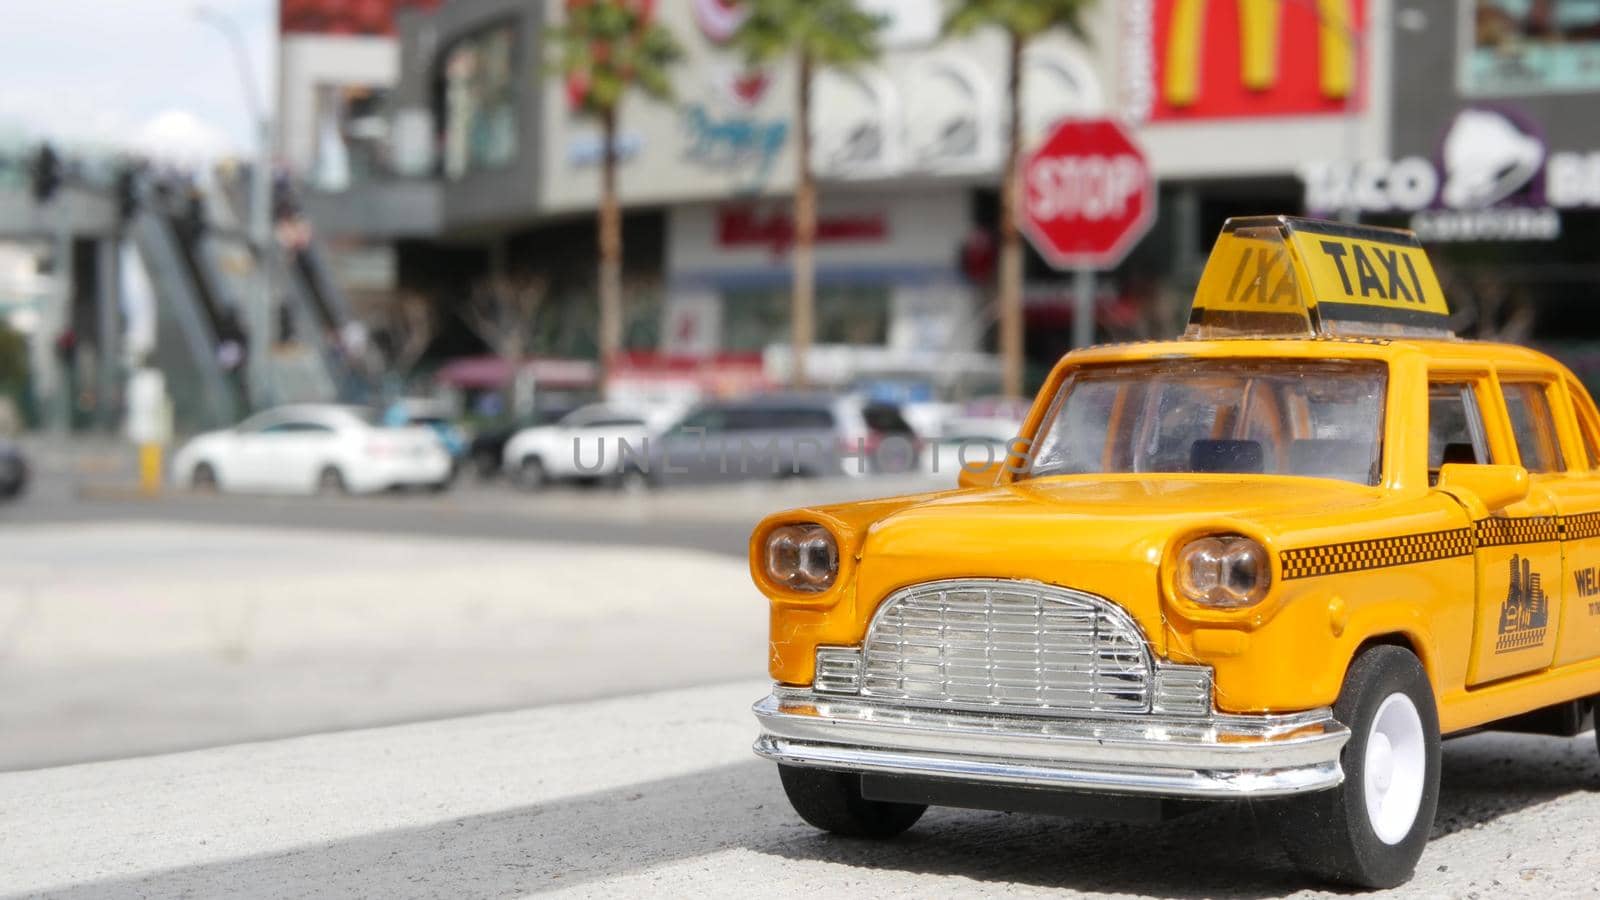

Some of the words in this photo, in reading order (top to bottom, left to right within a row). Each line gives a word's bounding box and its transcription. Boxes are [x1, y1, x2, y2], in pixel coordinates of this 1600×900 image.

[1026, 154, 1143, 220] STOP
[1304, 155, 1438, 212] TACO
[1574, 566, 1600, 598] WEL
